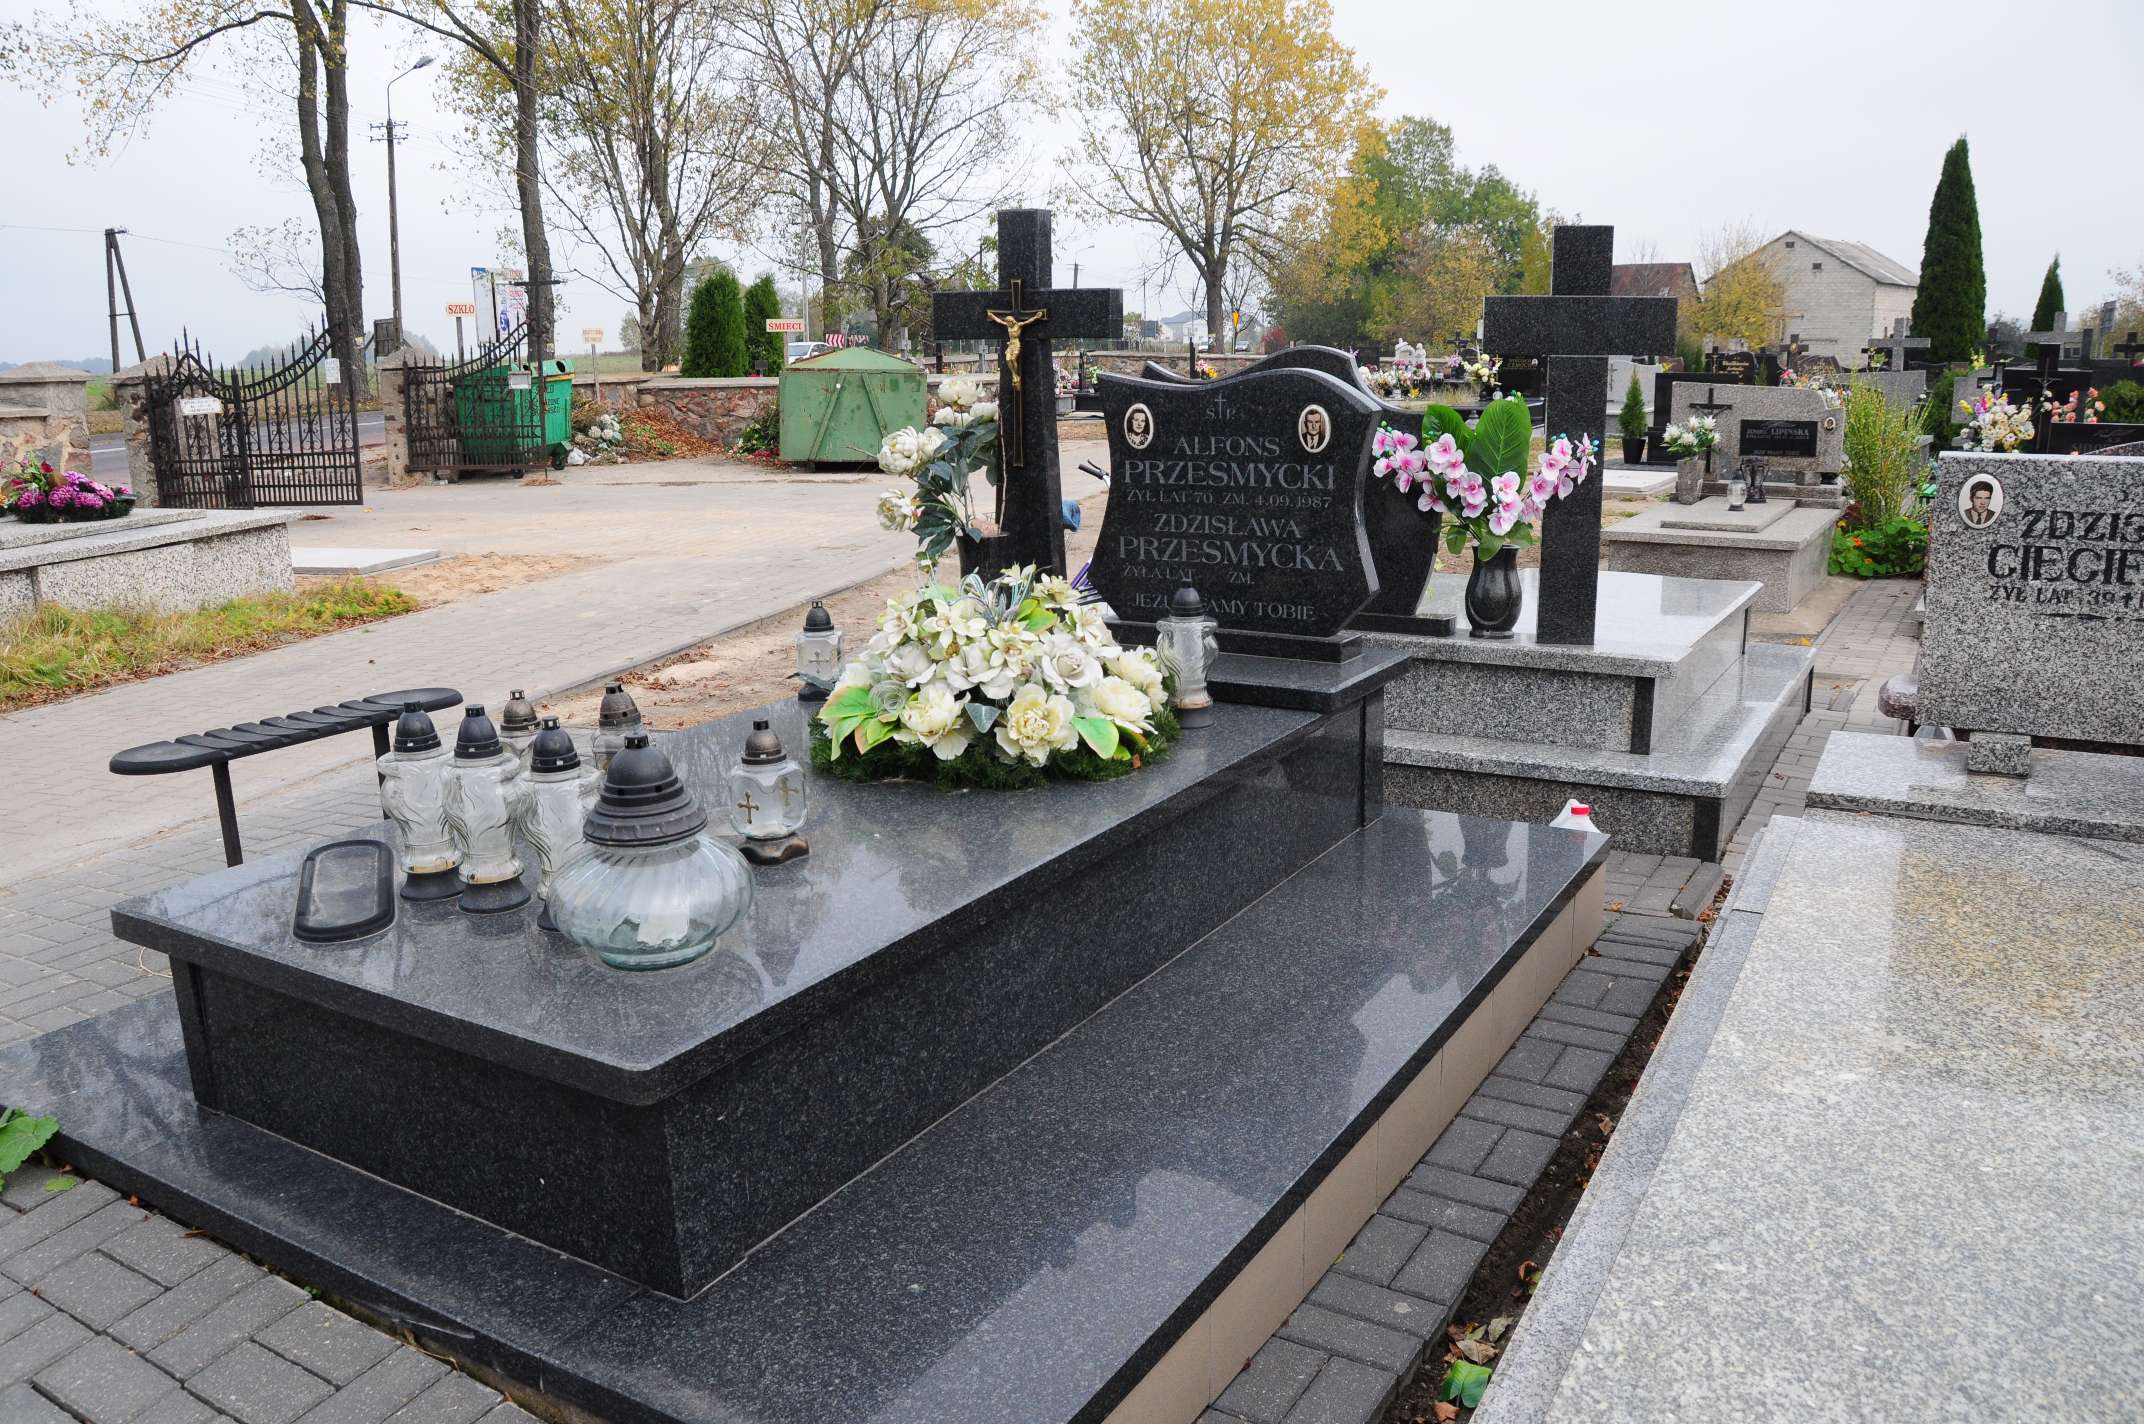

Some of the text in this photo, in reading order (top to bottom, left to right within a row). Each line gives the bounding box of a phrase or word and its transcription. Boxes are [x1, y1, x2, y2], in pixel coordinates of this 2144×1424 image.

[448, 304, 475, 315] SZKŁO
[768, 321, 802, 331] ŚMIECI
[1173, 435, 1280, 457] ALFONS
[1123, 459, 1335, 490] PRZESMYCKI
[1159, 489, 1190, 504] LAT
[1154, 513, 1302, 538] ZDZISŁAWA
[1119, 535, 1345, 572] PRZESMYCKA
[1166, 567, 1196, 582] LAT
[1200, 598, 1249, 617] AMY
[1253, 601, 1317, 621] TOBIE
